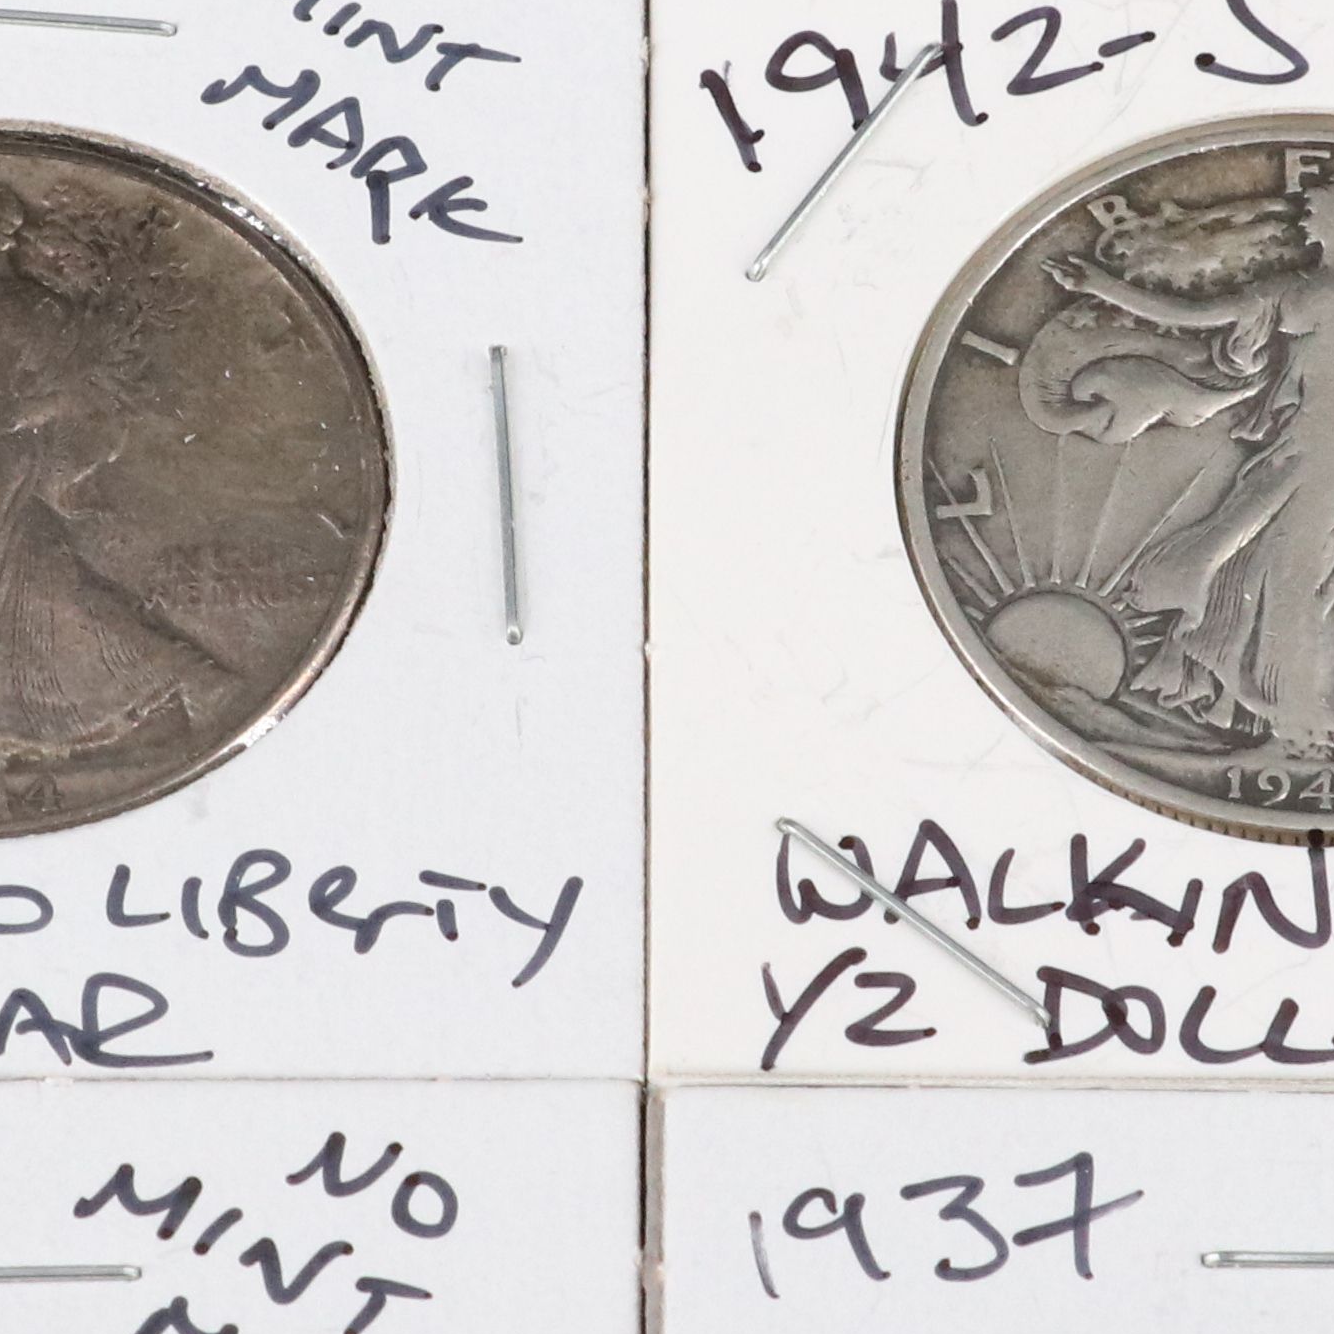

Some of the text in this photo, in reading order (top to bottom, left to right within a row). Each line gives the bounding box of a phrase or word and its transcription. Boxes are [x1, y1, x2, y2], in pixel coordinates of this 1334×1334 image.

[199, 64, 524, 246] MARK
[285, 1130, 459, 1239] NO
[748, 1151, 1144, 1300] 1937
